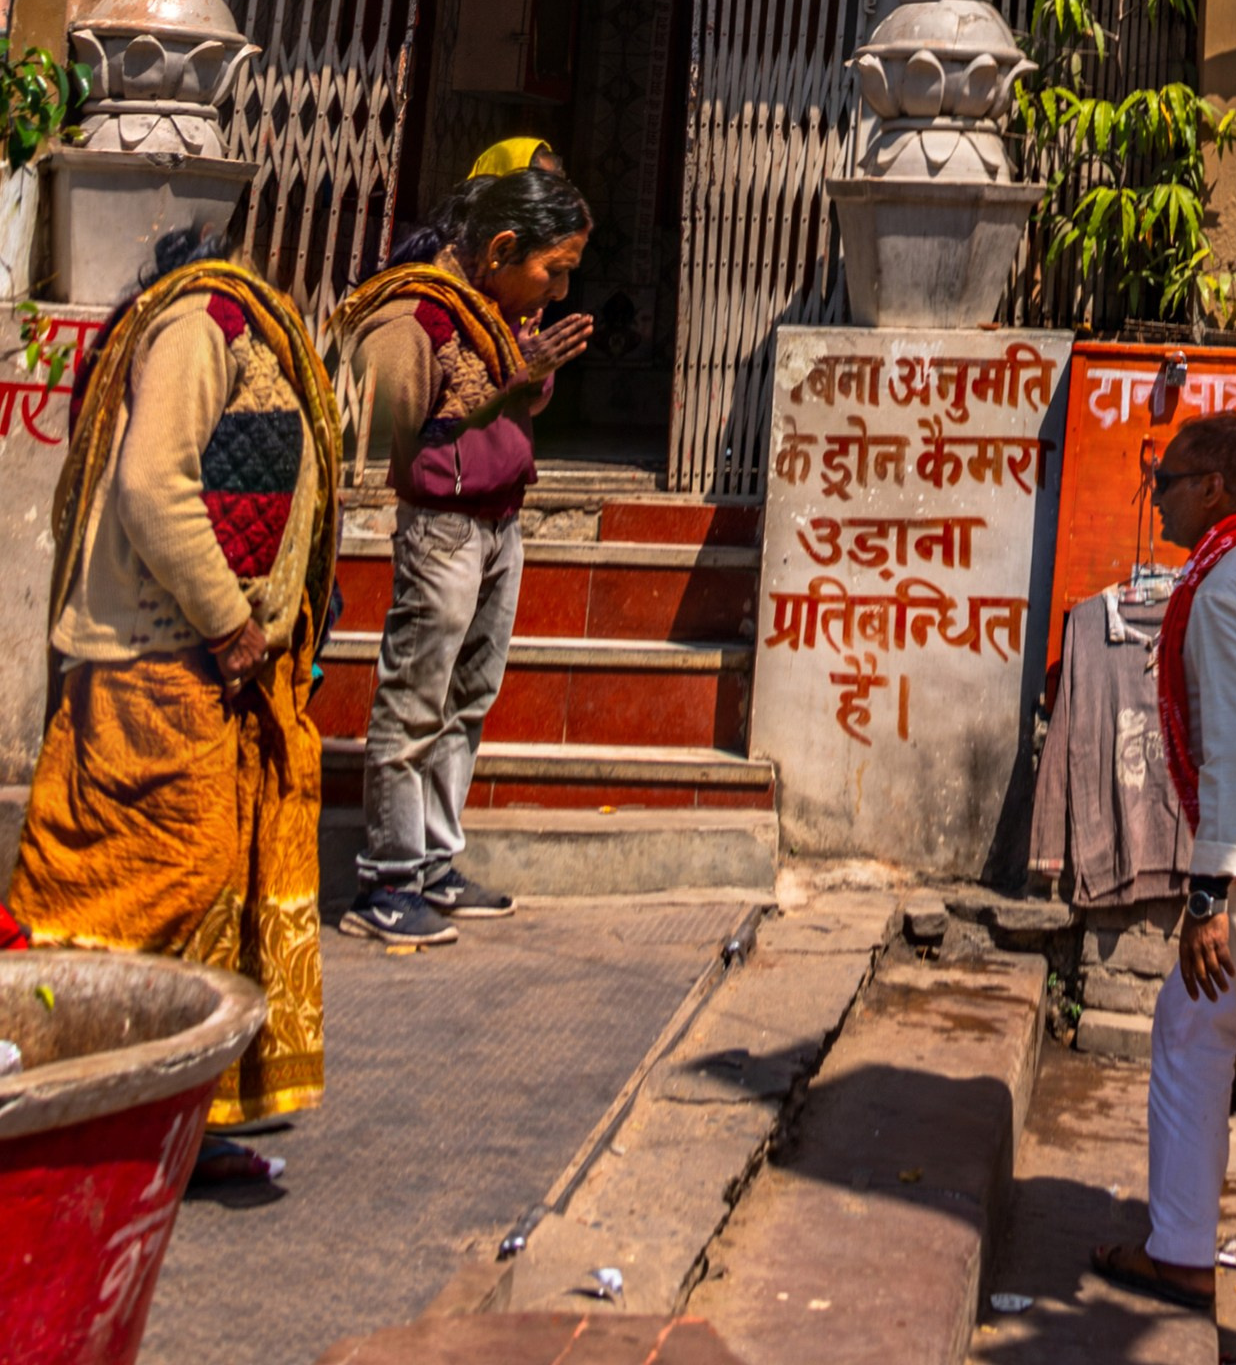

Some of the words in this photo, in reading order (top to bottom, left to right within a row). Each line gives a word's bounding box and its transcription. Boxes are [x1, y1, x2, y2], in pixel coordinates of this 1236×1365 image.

[889, 342, 1058, 424] अनुमति
[775, 414, 818, 486] के
[820, 415, 911, 501] ड्रोन
[917, 414, 1057, 495] कैमरा
[796, 516, 988, 581] उड़ाना
[764, 576, 1031, 664] प्रतिबन्धित
